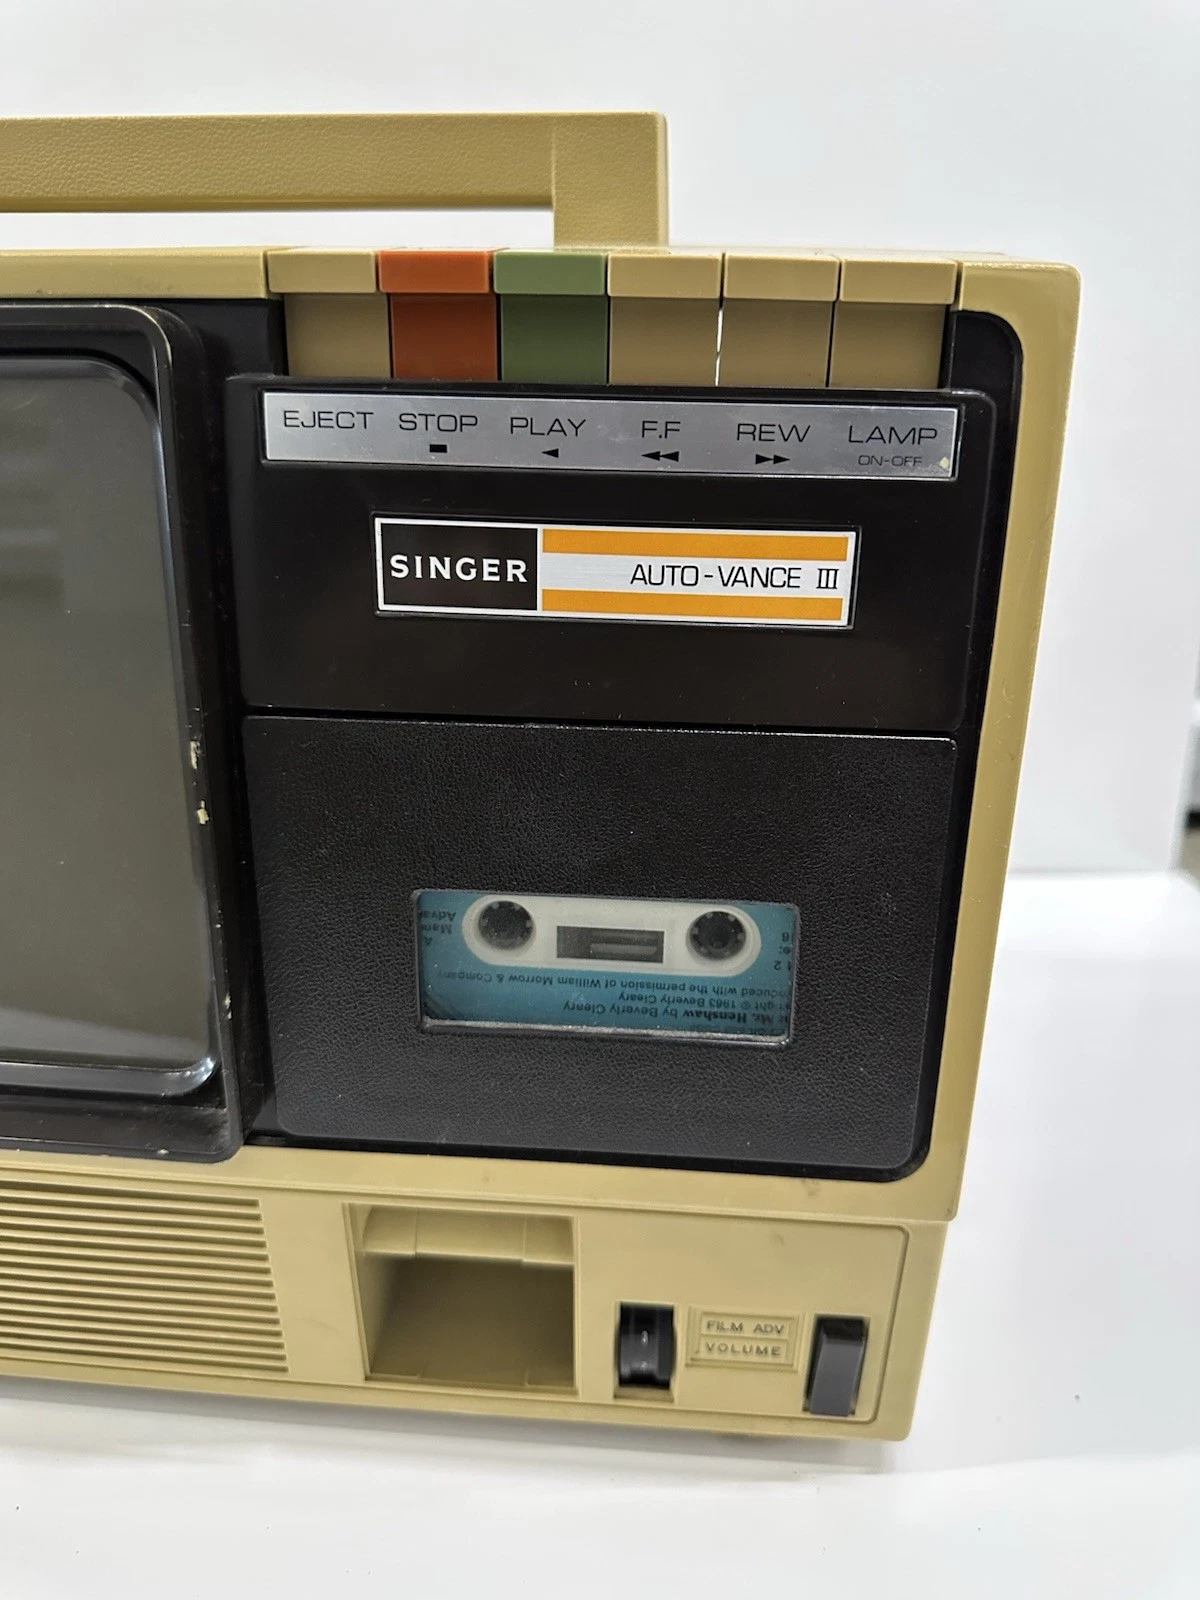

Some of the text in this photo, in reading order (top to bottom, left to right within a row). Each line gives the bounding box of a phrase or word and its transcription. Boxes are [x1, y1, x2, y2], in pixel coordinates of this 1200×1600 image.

[283, 410, 374, 429] EJECT
[399, 413, 478, 432] STOP
[510, 416, 586, 436] PLAY
[641, 420, 681, 439] F.F
[736, 423, 811, 442] REW
[848, 425, 938, 445] LAMP
[858, 454, 922, 467] ON-OFF
[389, 554, 528, 583] SINGER
[816, 567, 838, 590] III
[496, 973, 504, 982] &
[508, 973, 553, 986] Morrow
[557, 976, 601, 989] William
[606, 978, 616, 988] of
[621, 980, 685, 992] permission
[690, 984, 707, 994] the
[713, 985, 737, 995] with
[619, 991, 657, 1005] Cleary
[661, 994, 704, 1009] Beverly
[609, 1002, 658, 1018] Beverly
[662, 1005, 678, 1018] by
[683, 1009, 747, 1024] Henshaw
[706, 1319, 785, 1335] FILM ADV
[705, 1342, 781, 1357] VOLUME
